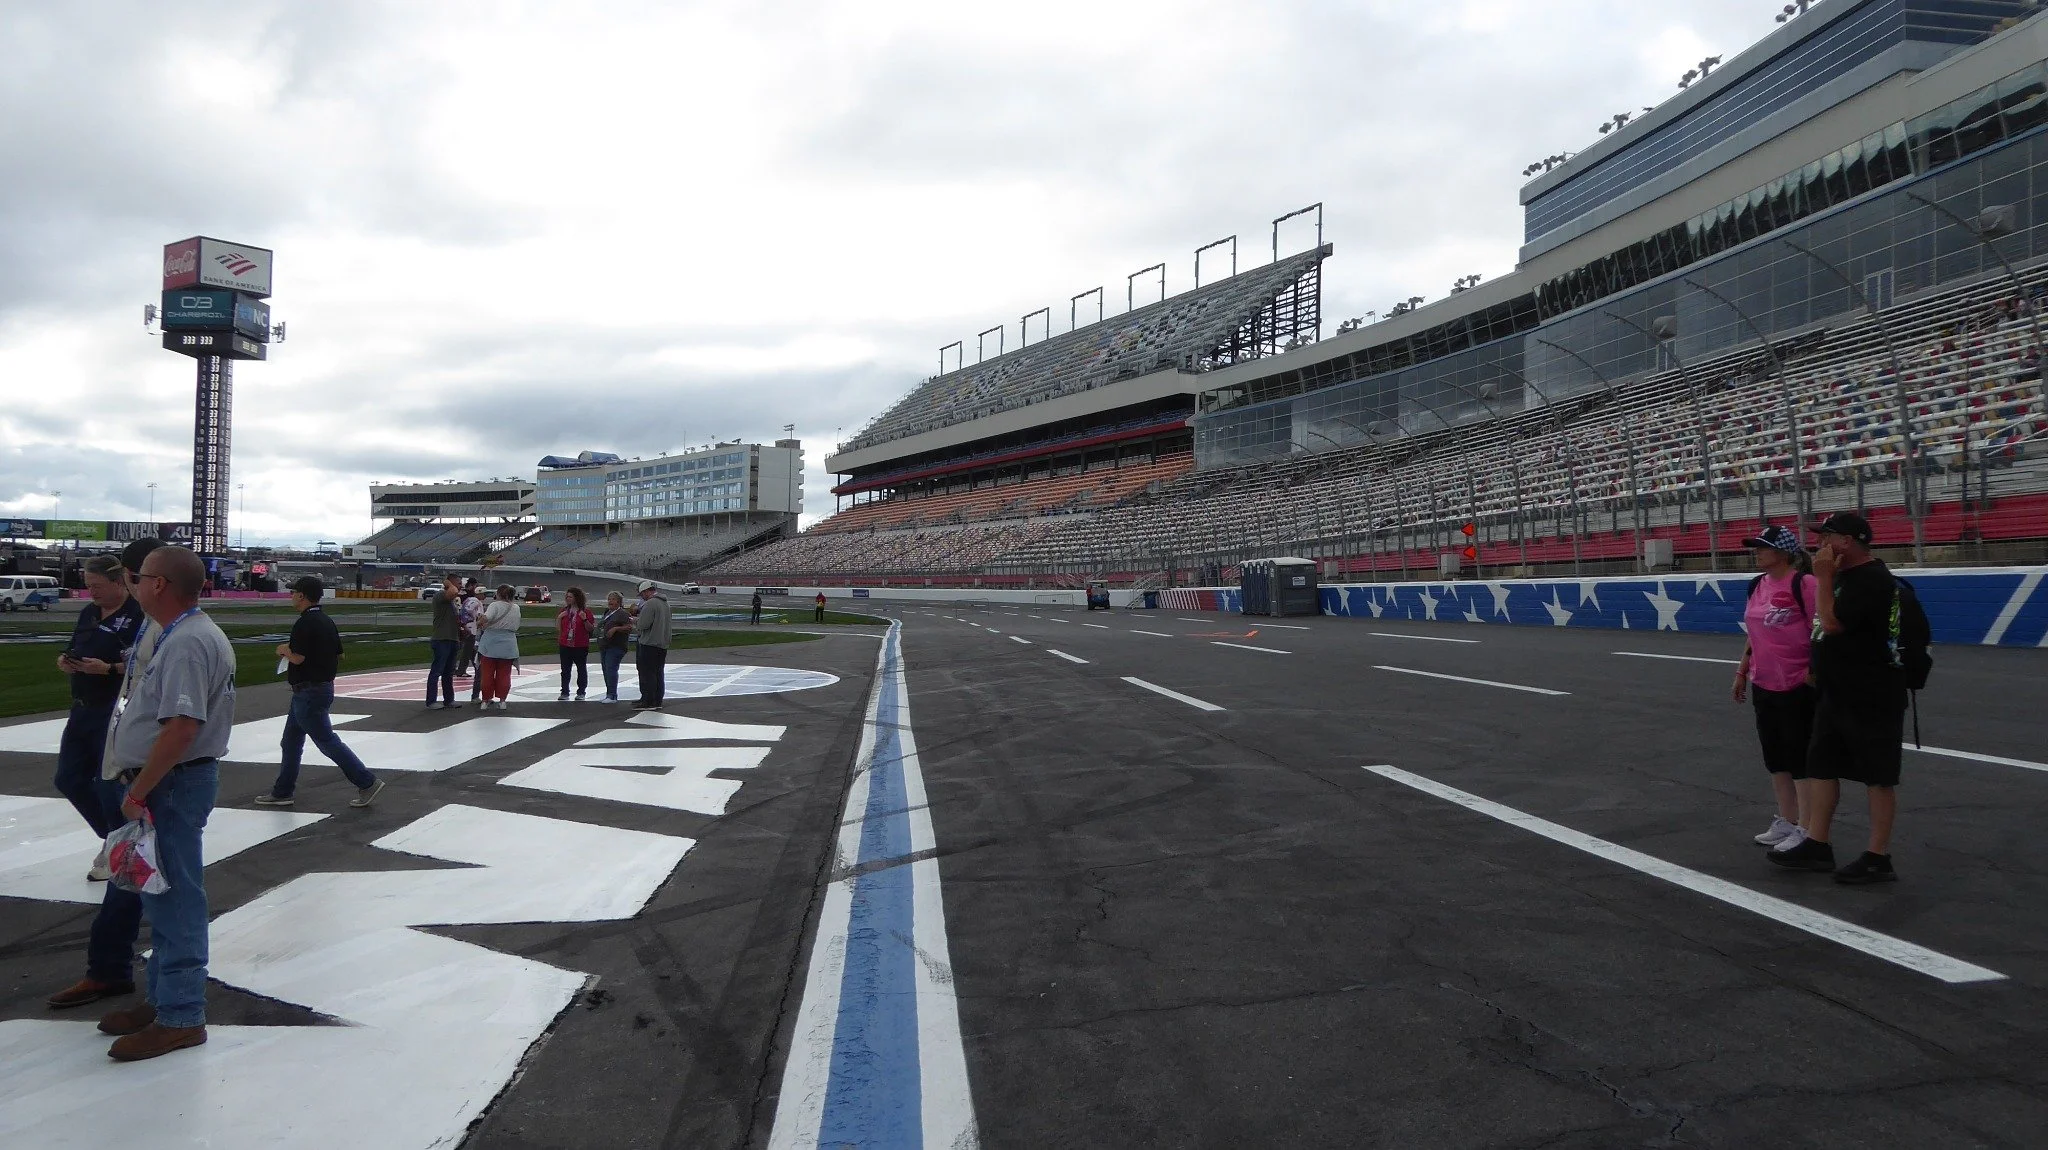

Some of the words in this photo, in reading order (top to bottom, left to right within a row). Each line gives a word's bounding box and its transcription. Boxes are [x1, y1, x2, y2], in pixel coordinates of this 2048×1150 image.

[203, 275, 223, 285] BANK
[225, 279, 234, 287] OF
[236, 281, 267, 292] AMERICA
[167, 311, 226, 319] CHARBROIL
[253, 308, 268, 328] NC
[182, 335, 196, 345] 333
[200, 335, 213, 345] 333
[211, 364, 219, 372] 33
[211, 374, 219, 382] 33
[210, 382, 219, 390] 33
[210, 400, 218, 408] 33
[209, 418, 217, 426] 33
[208, 436, 217, 444] 33
[208, 454, 216, 462] 33
[207, 472, 216, 480] 33
[206, 490, 215, 498] 33
[206, 508, 214, 516] 33
[52, 522, 98, 534] EchoPark
[113, 523, 128, 540] LAS
[129, 523, 160, 540] VEGAS
[205, 526, 214, 534] 33
[193, 536, 202, 544] 33
[205, 536, 213, 544] 33
[193, 544, 201, 552] 33
[205, 544, 213, 552] 33
